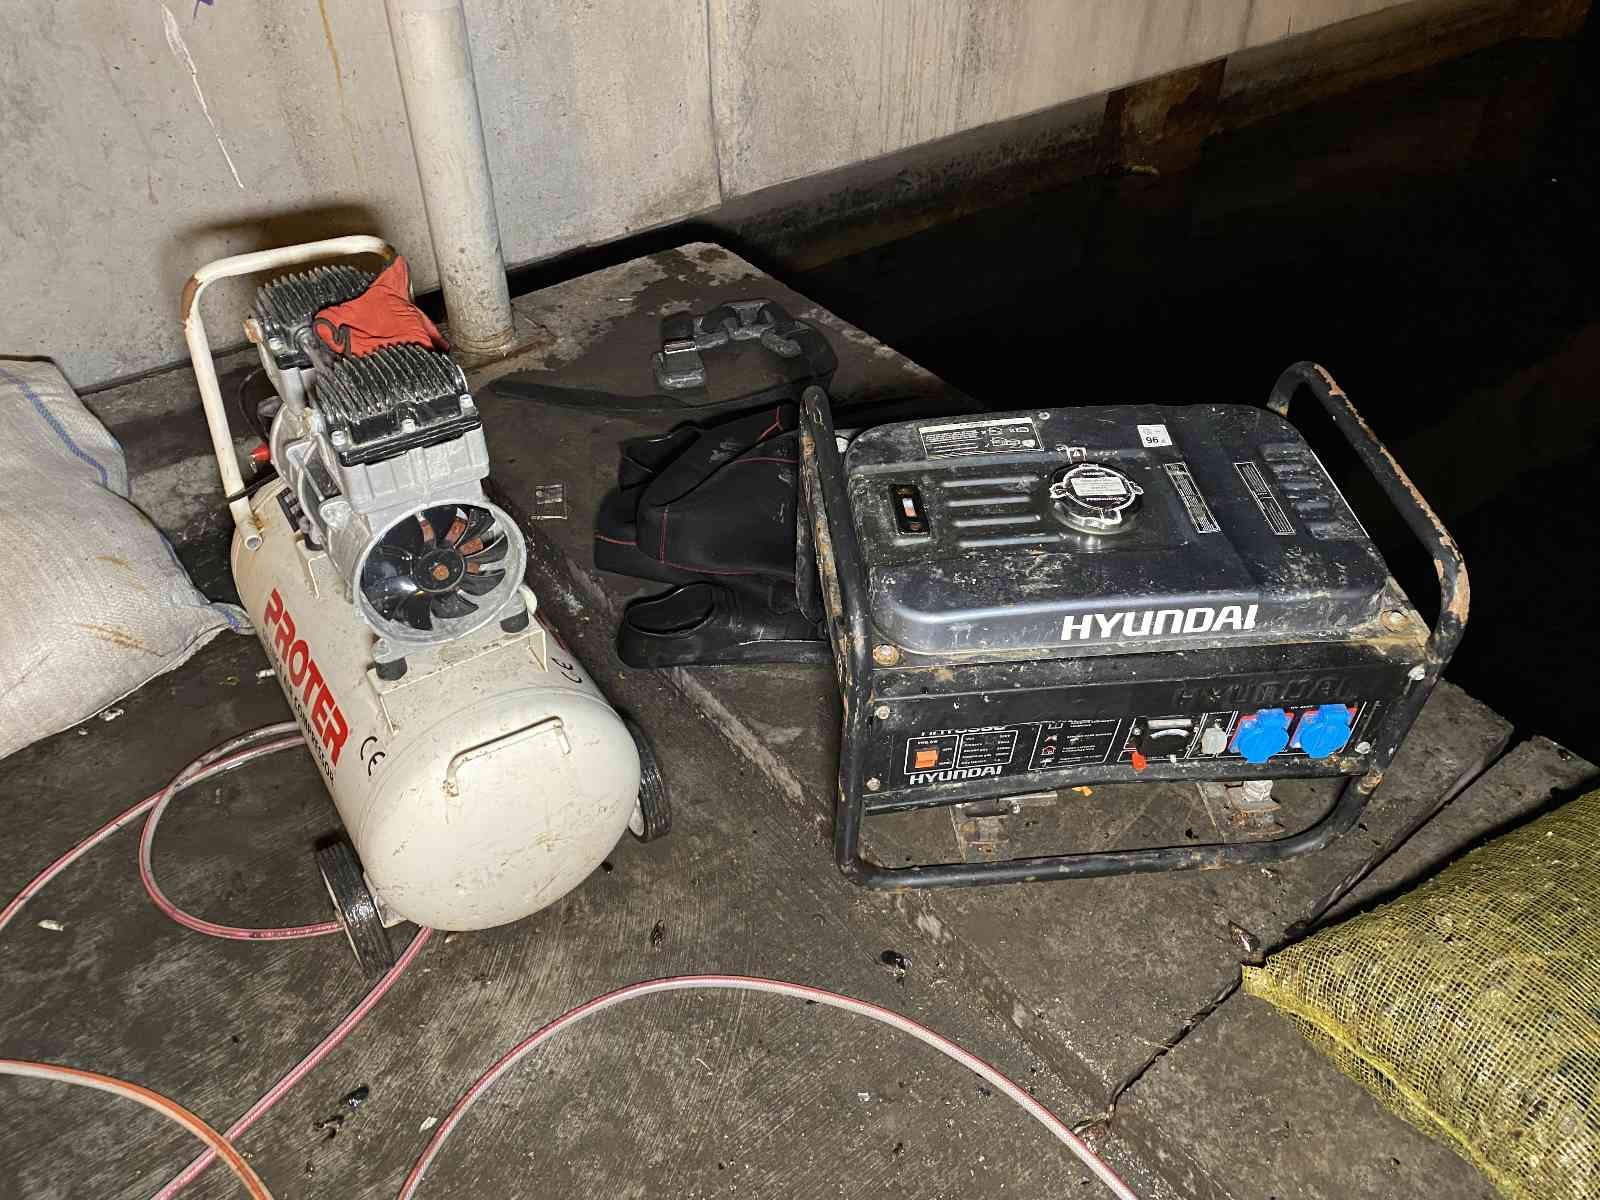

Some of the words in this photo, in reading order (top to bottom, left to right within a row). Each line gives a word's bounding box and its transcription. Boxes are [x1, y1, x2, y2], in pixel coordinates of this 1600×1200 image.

[1061, 604, 1259, 641] HYUNDAI
[264, 587, 349, 768] PROTER
[909, 766, 1003, 785] HYUNDAI
